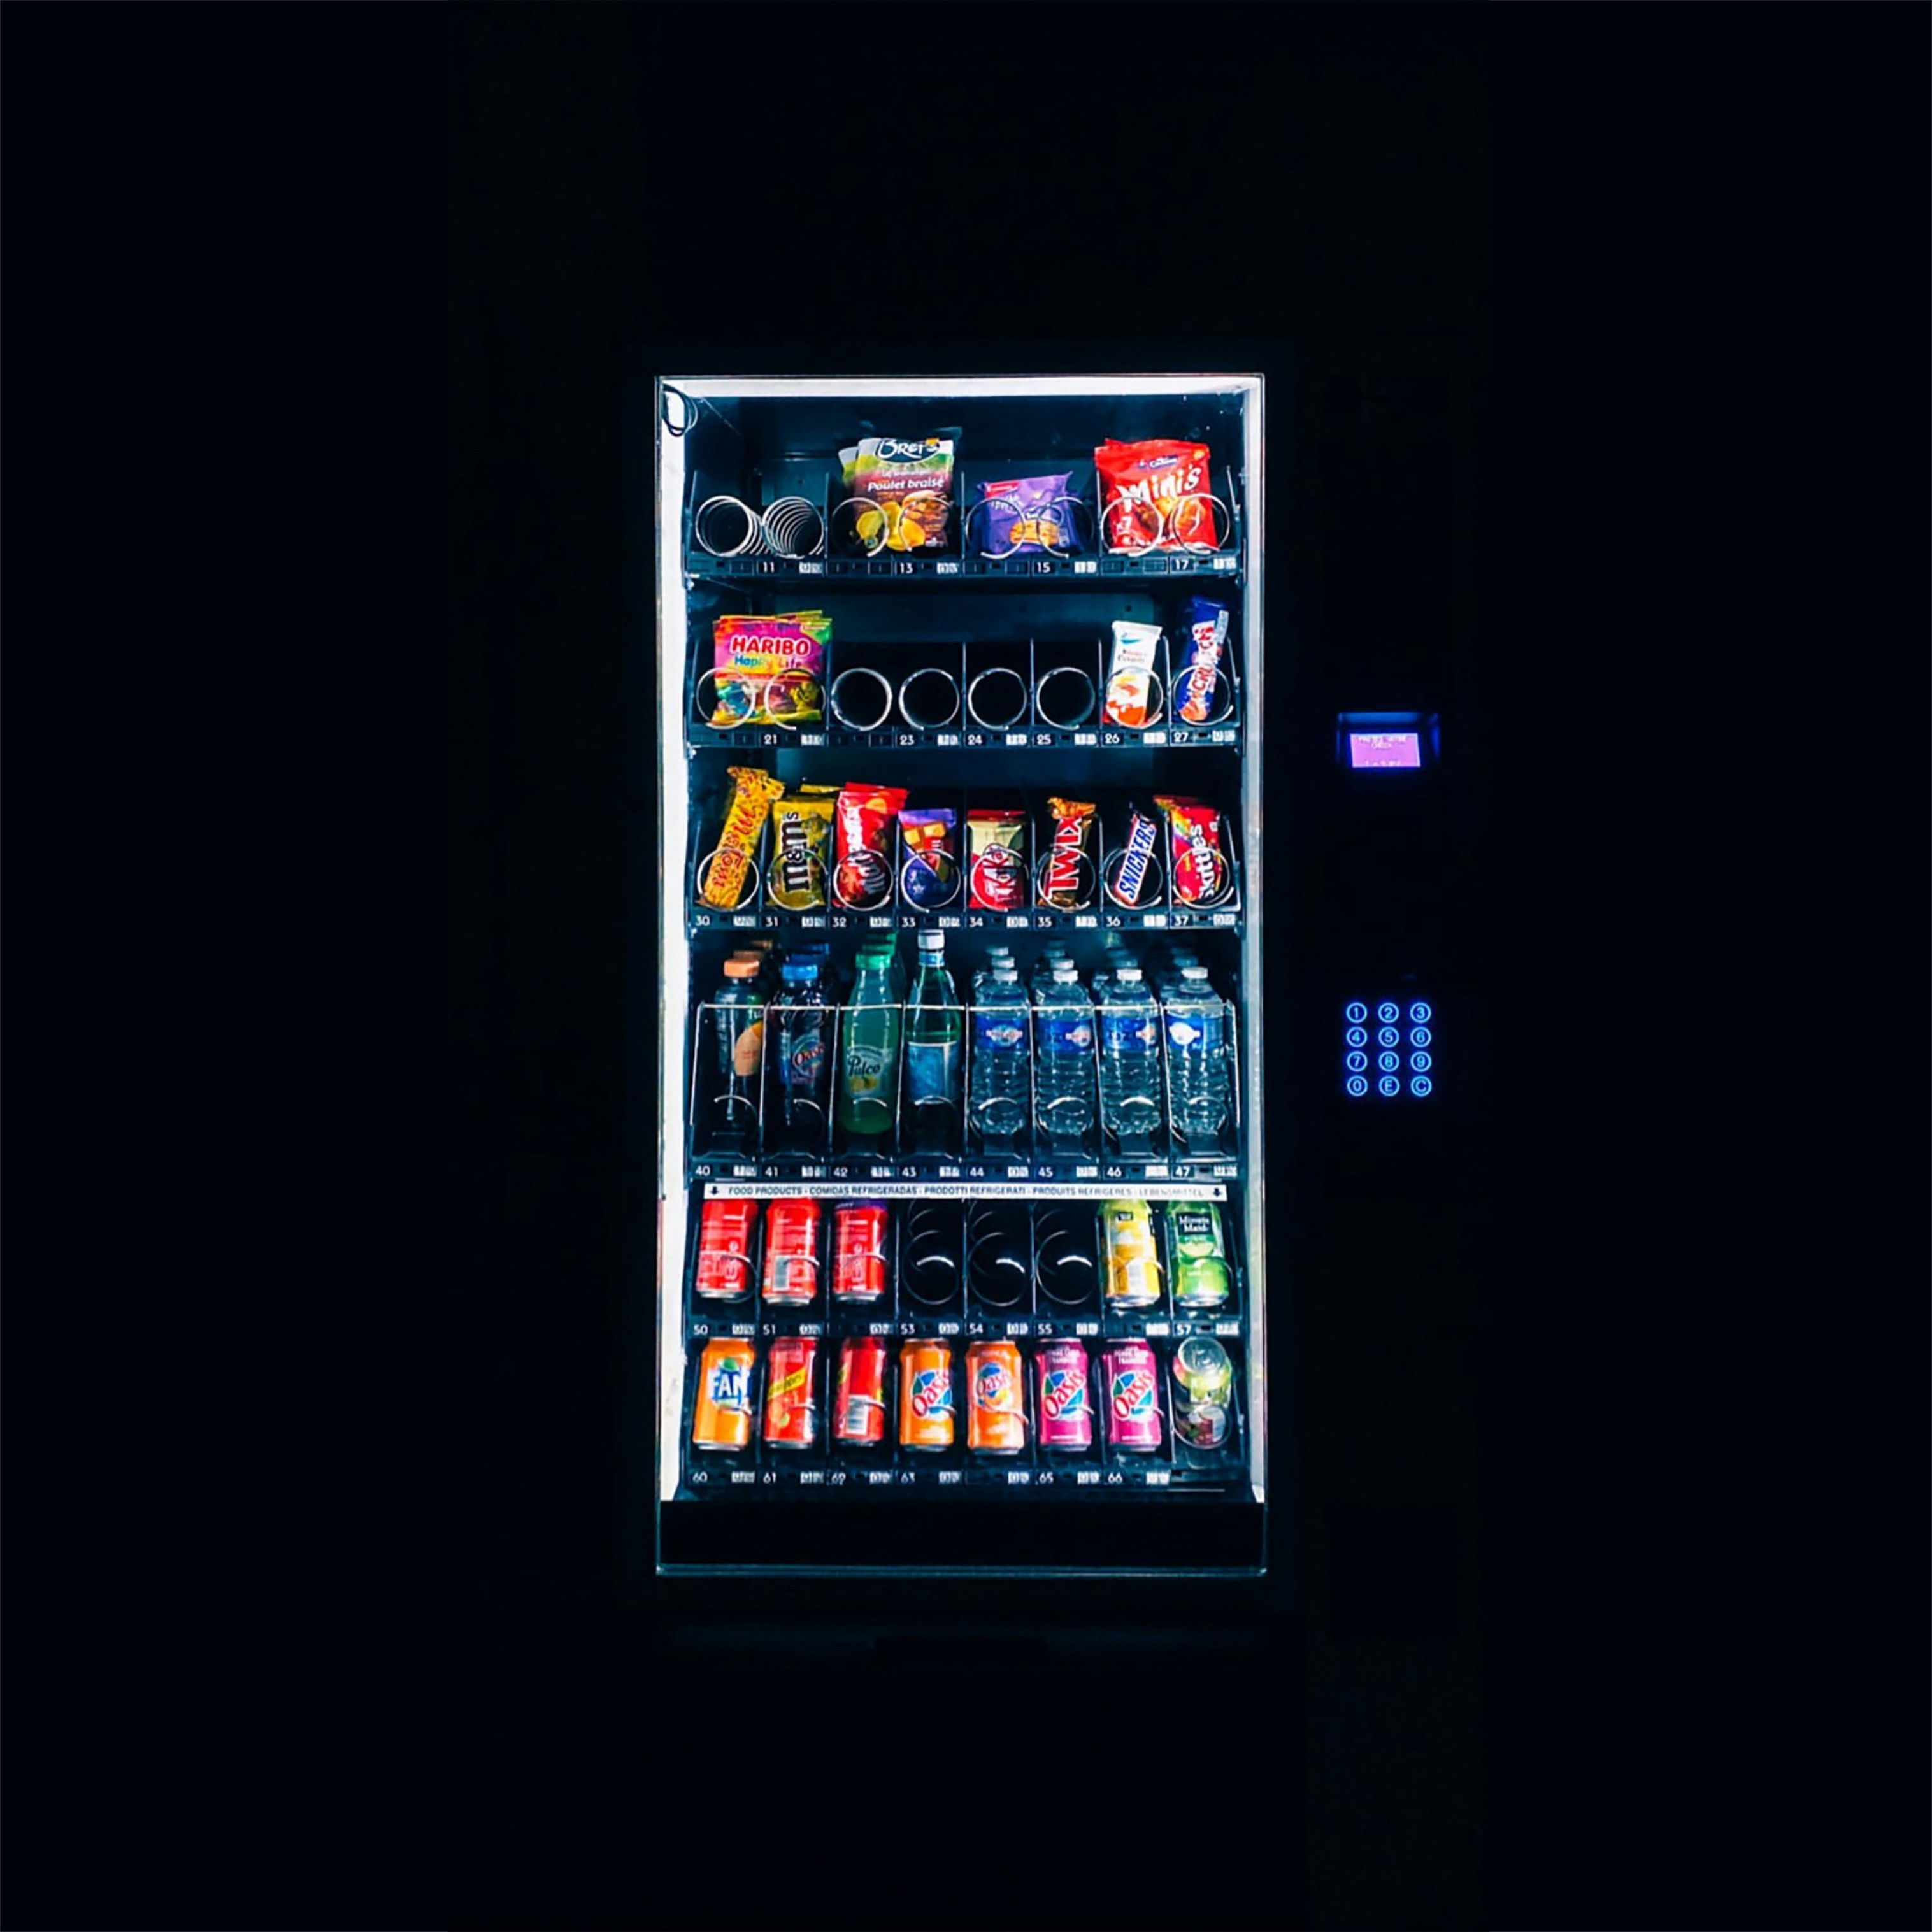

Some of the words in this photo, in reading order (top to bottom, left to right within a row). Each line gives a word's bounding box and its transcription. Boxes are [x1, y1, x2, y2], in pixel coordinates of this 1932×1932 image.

[868, 479, 905, 492] Poulet
[763, 562, 775, 573] 11
[900, 562, 913, 574] 13
[1037, 562, 1050, 573] 15
[1175, 559, 1190, 570] 17
[731, 636, 810, 656] HARIBO
[764, 734, 777, 745] 21
[900, 734, 914, 745] 23
[968, 734, 982, 745] 24
[1037, 734, 1052, 745] 25
[1105, 733, 1120, 744] 26
[1174, 731, 1189, 743] 27
[1045, 818, 1082, 899] TWIX
[1119, 818, 1155, 899] SNICKERS
[695, 915, 710, 927] 30
[766, 917, 778, 927] 31
[833, 917, 847, 927] 32
[902, 917, 916, 927] 33
[970, 917, 983, 927] 34
[1038, 917, 1052, 927] 35
[1106, 916, 1121, 927] 36
[1175, 915, 1189, 927] 37
[848, 1055, 881, 1076] Pulco
[695, 1166, 710, 1176] 40
[765, 1167, 778, 1177] 41
[834, 1167, 848, 1177] 42
[902, 1166, 917, 1177] 43
[970, 1167, 984, 1177] 44
[1038, 1167, 1053, 1177] 45
[1107, 1166, 1122, 1177] 46
[1175, 1166, 1190, 1178] 47
[729, 1186, 752, 1195] FOOD
[755, 1186, 802, 1195] PRODUCTS
[810, 1186, 849, 1195] COMIDAS
[1033, 1187, 1076, 1196] PRODUITS
[694, 1324, 708, 1335] 50
[763, 1324, 776, 1335] 51
[901, 1324, 915, 1334] 53
[970, 1323, 984, 1334] 54
[1038, 1324, 1052, 1335] 55
[1177, 1324, 1191, 1335] 57
[1044, 1370, 1084, 1418] Oasis
[1114, 1372, 1154, 1419] Oasis
[692, 1471, 708, 1483] 60
[763, 1472, 776, 1482] 61
[901, 1471, 915, 1483] 63
[1039, 1472, 1054, 1482] 65
[1108, 1472, 1122, 1483] 66
